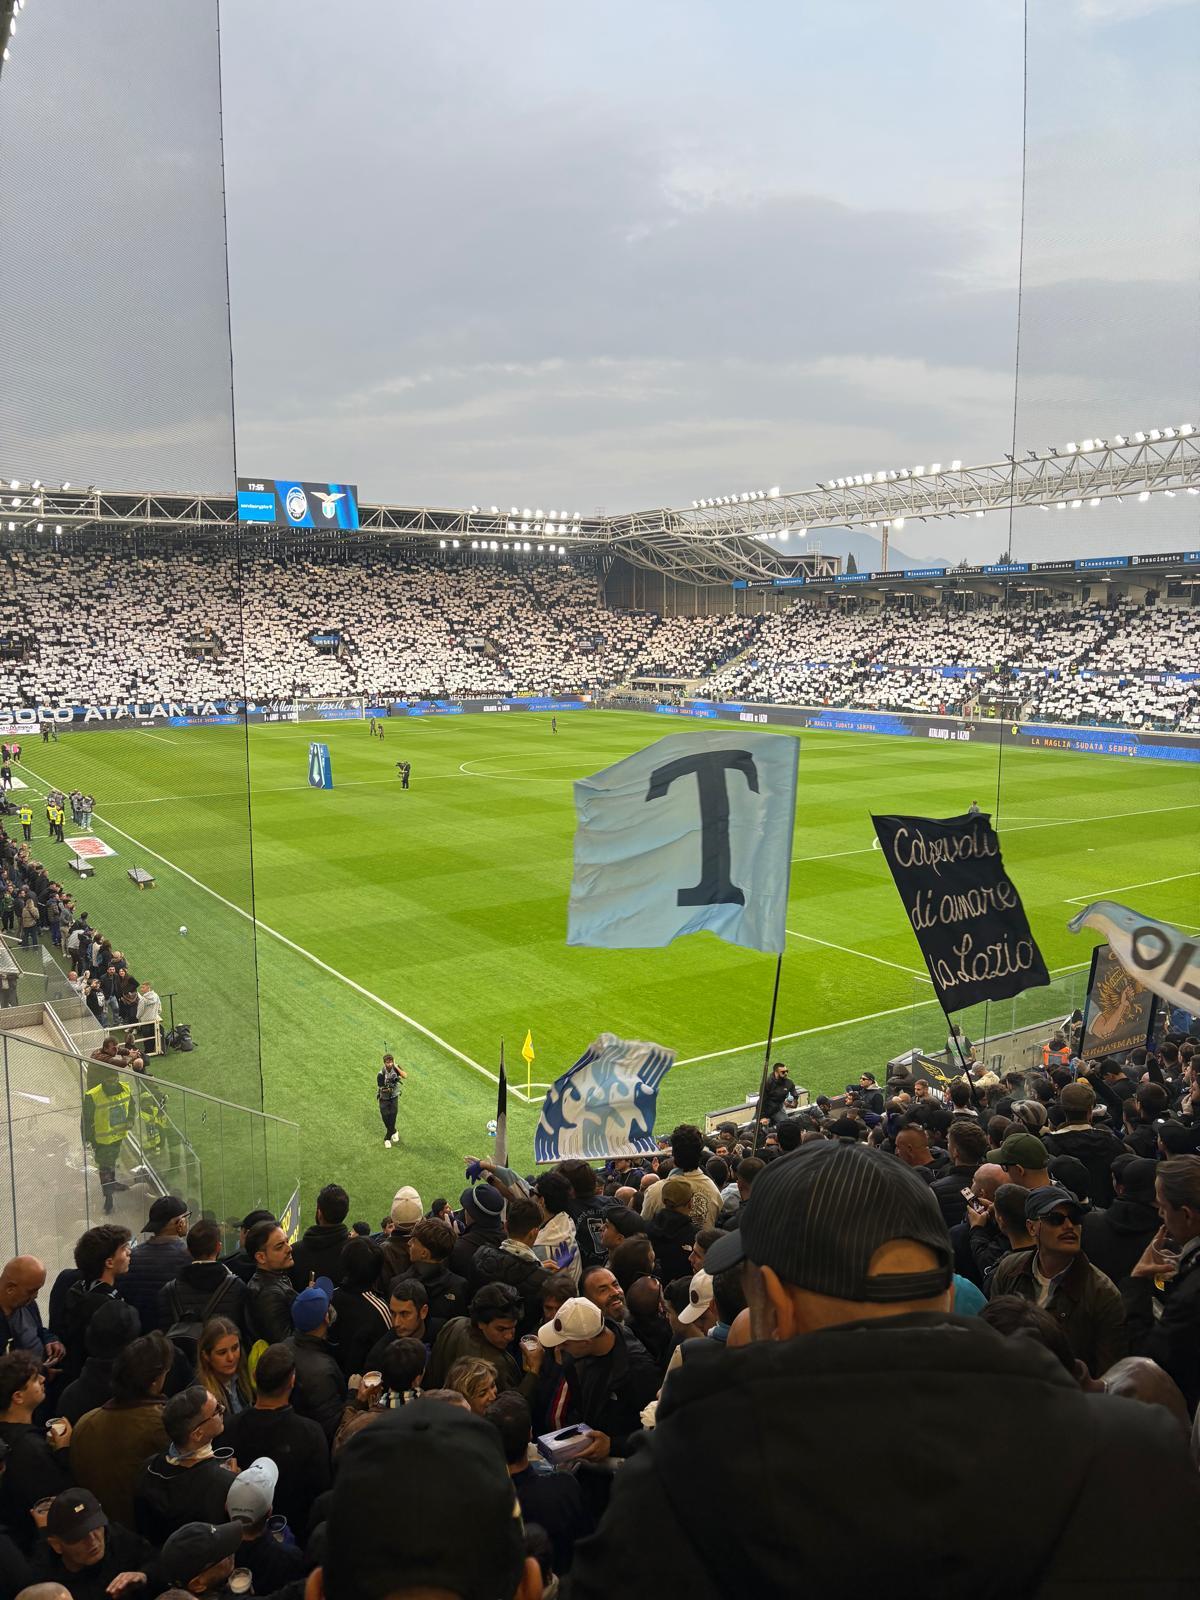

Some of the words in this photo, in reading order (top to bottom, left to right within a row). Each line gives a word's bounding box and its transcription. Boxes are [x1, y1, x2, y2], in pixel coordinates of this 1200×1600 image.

[84, 702, 220, 722] ATALANTA
[1044, 739, 1071, 748] MAGLIA
[1075, 741, 1104, 751] SUDATA
[1108, 744, 1138, 754] SEMPRE
[645, 749, 760, 907] T
[911, 889, 938, 931] di
[939, 881, 1017, 924] amare
[929, 953, 957, 991] la
[953, 933, 1034, 982] Lazio
